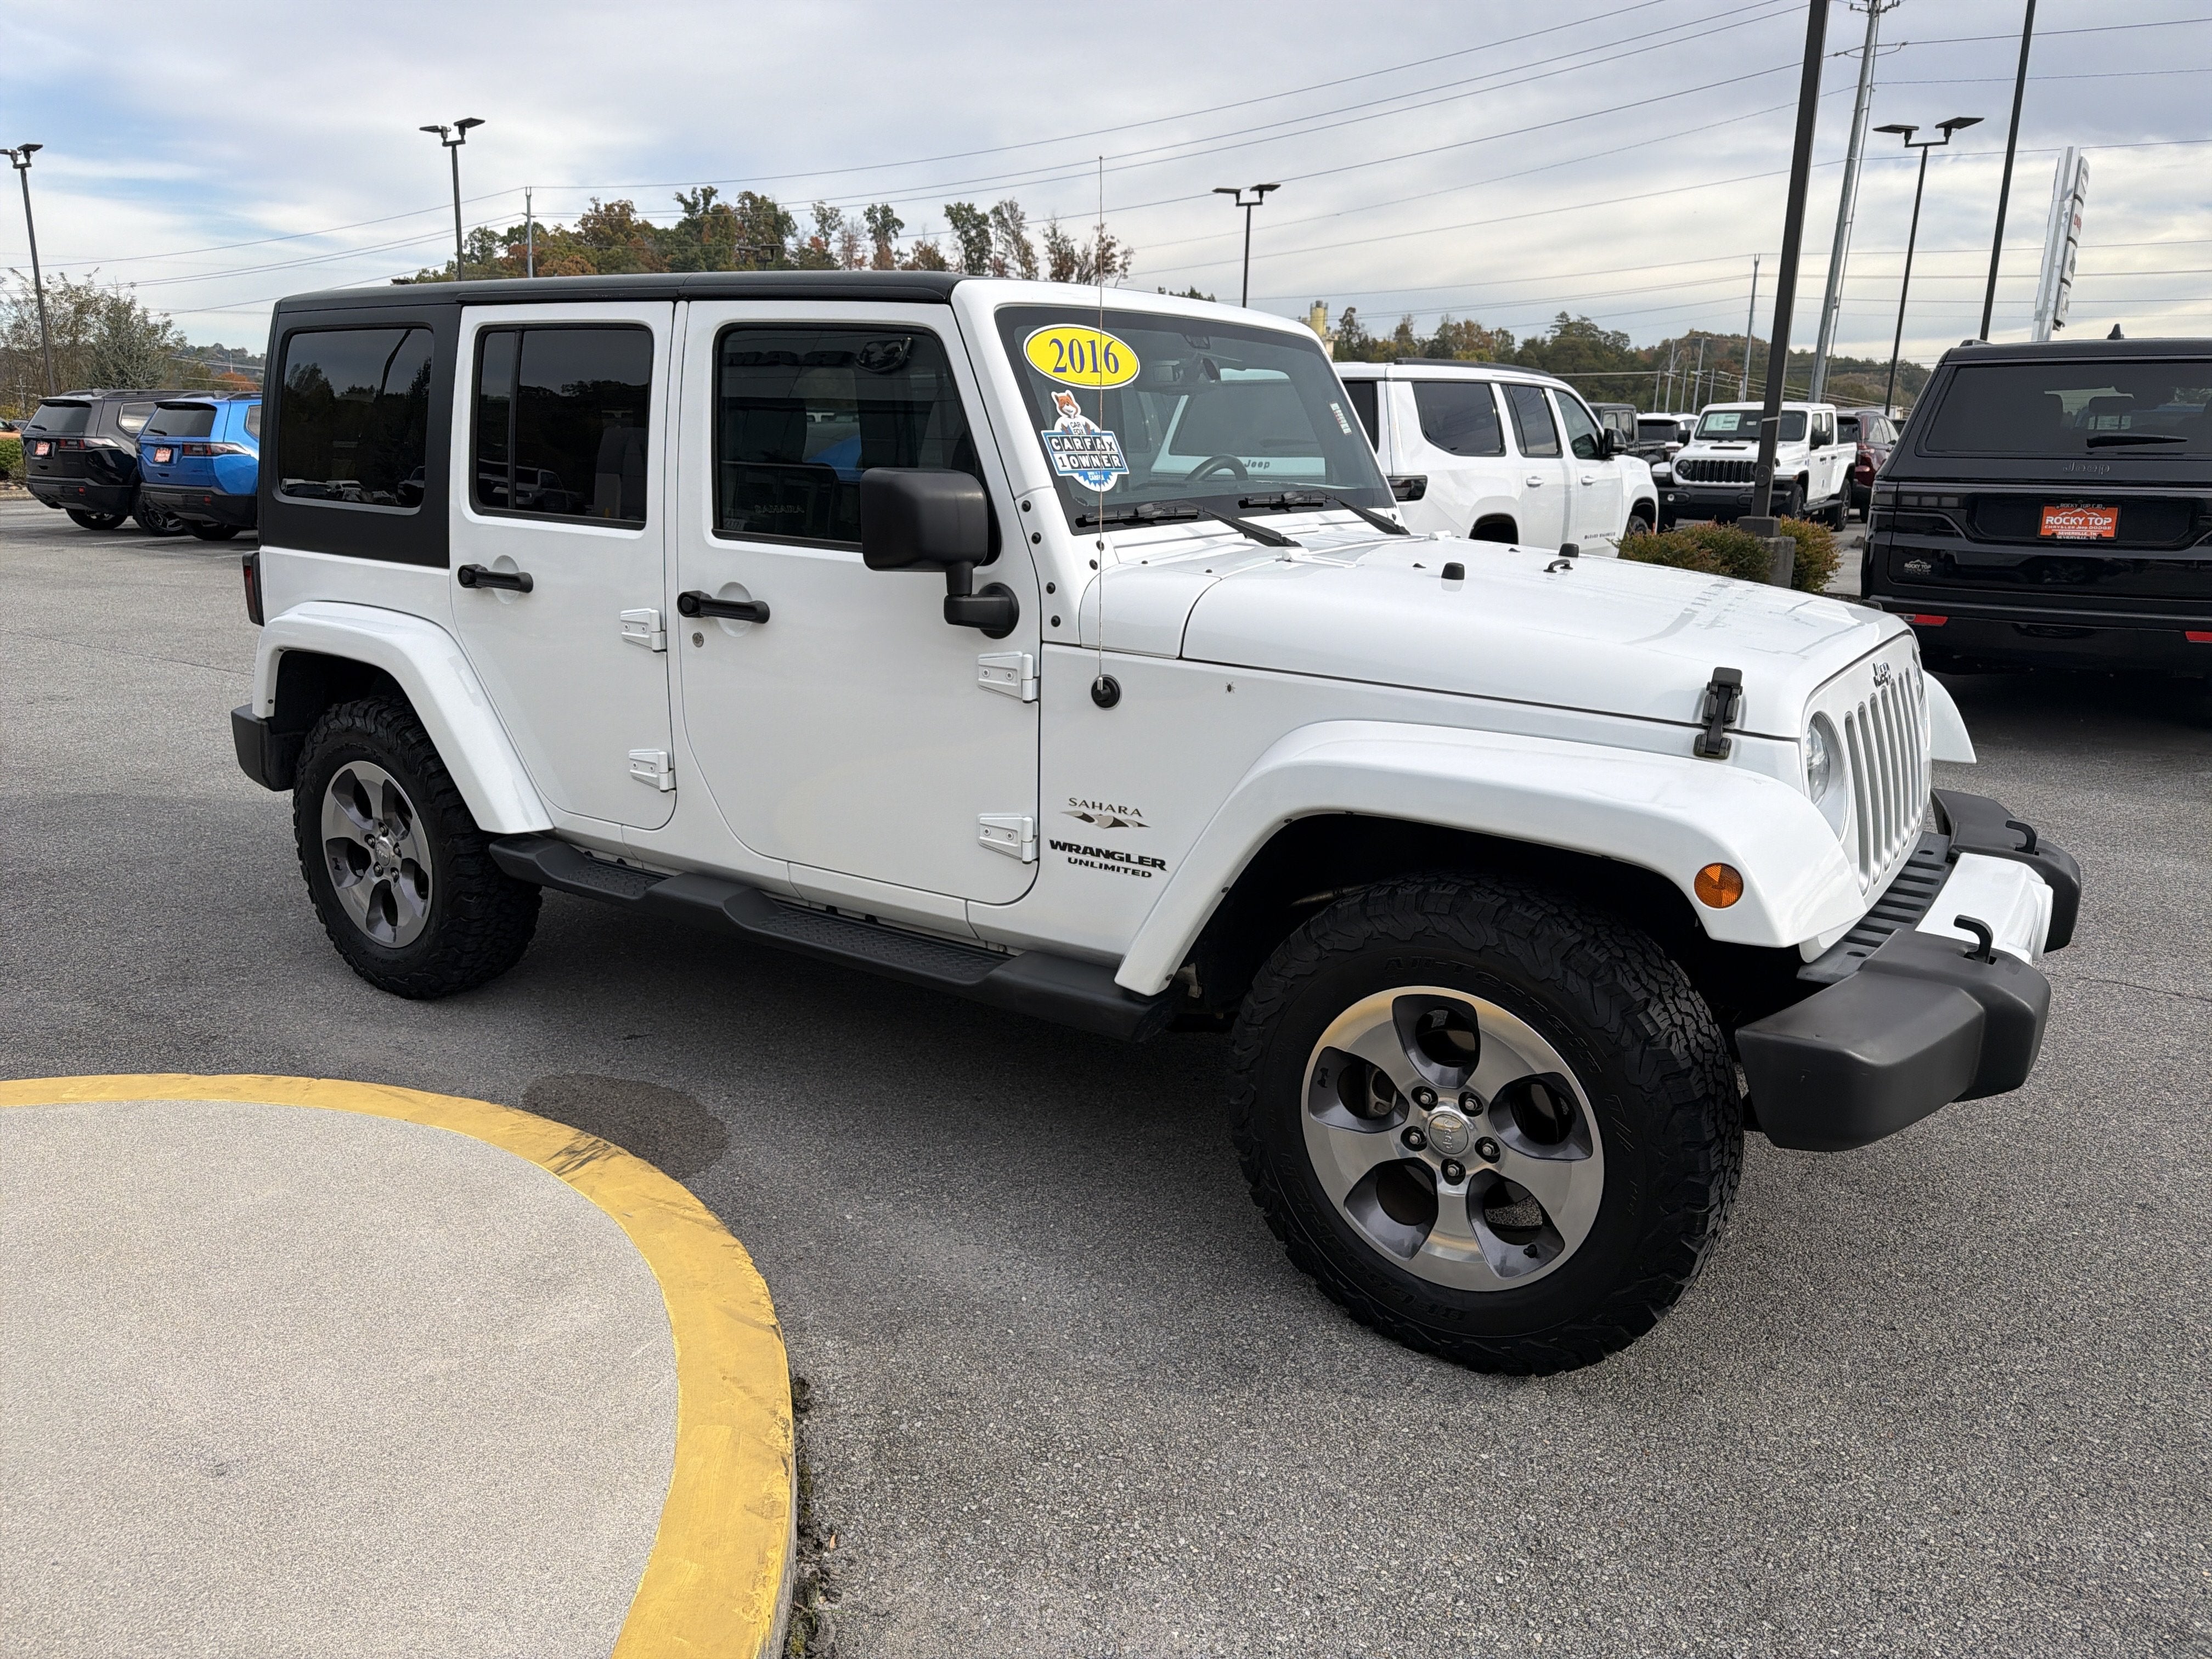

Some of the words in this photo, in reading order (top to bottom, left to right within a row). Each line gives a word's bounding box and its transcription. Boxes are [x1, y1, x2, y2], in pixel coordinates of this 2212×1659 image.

[1049, 338, 1119, 374] 2016
[1051, 438, 1116, 452] CARFAX
[1070, 455, 1122, 467] OWNER
[1244, 459, 1270, 469] Jeep
[2062, 461, 2111, 475] Jeep
[2045, 516, 2085, 525] ROCKY
[2087, 517, 2112, 526] TOP
[1069, 797, 1143, 817] SAHARA
[1049, 839, 1167, 871] WRANGLER
[1067, 857, 1153, 878] UNLIMITED
